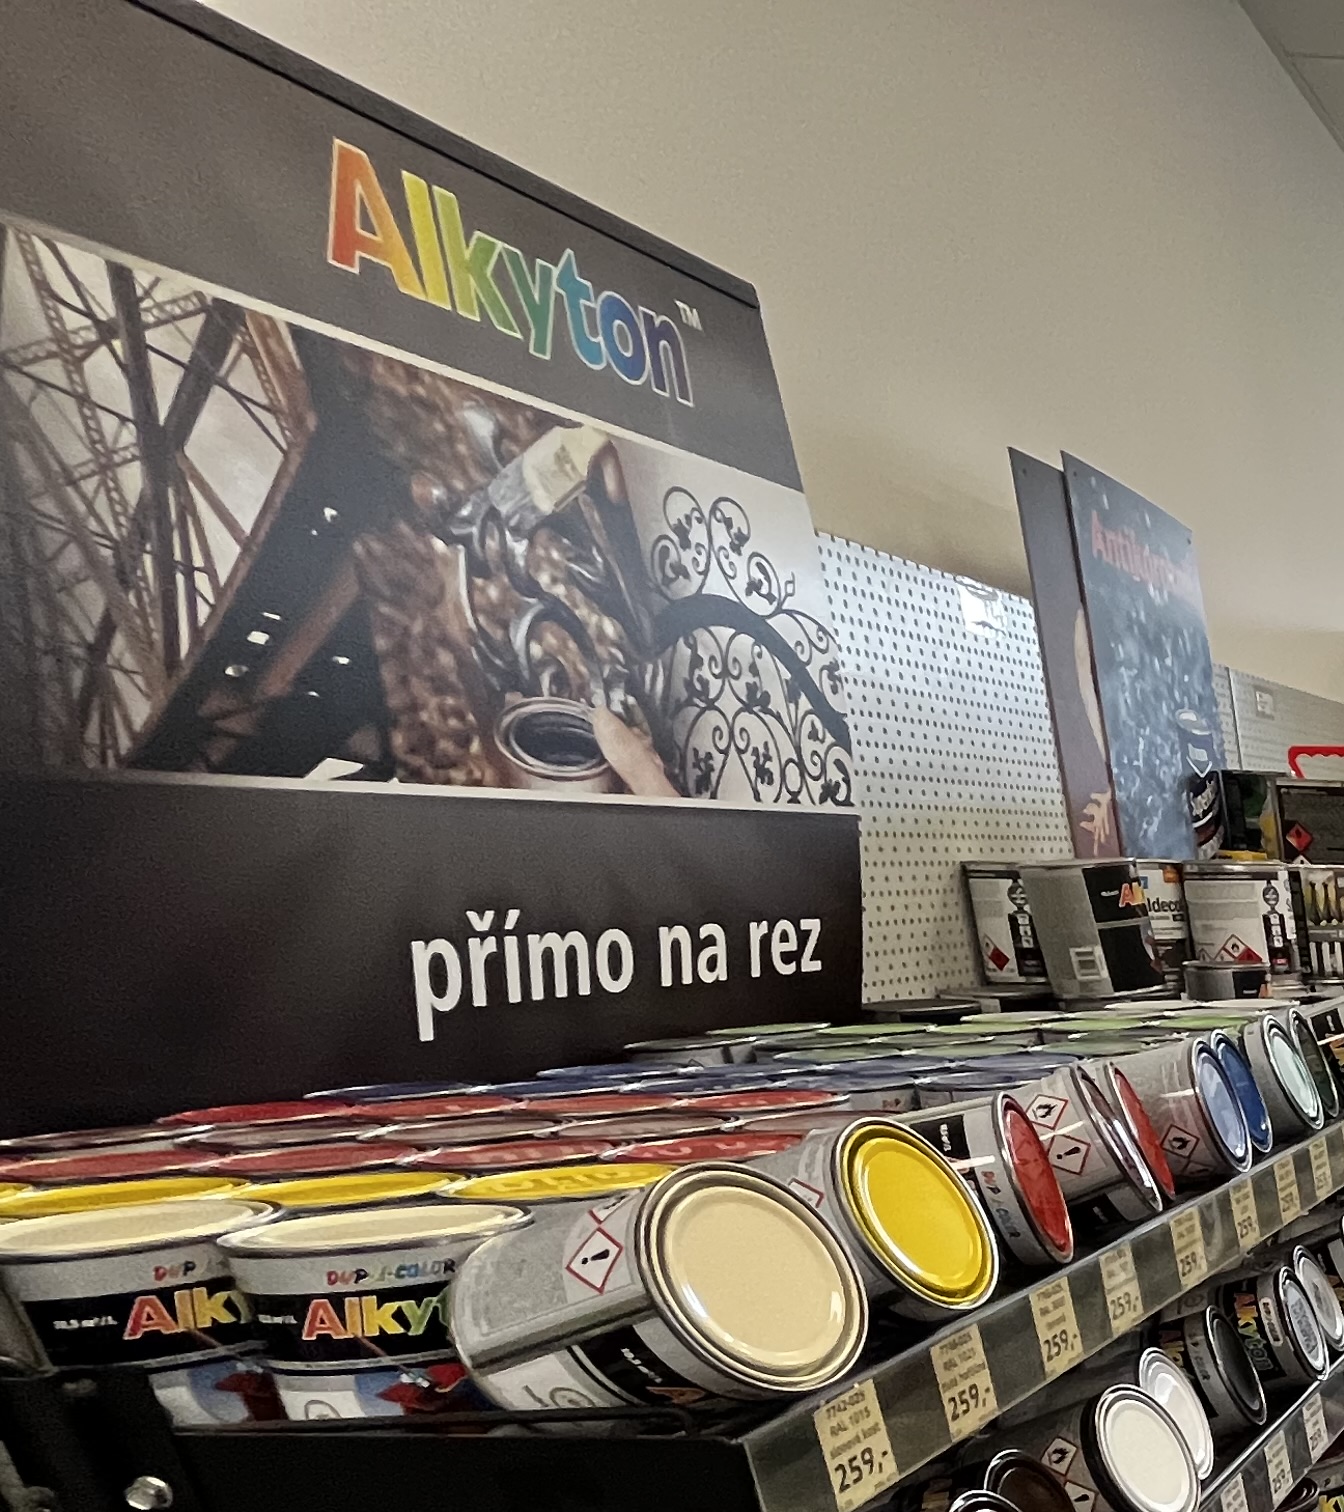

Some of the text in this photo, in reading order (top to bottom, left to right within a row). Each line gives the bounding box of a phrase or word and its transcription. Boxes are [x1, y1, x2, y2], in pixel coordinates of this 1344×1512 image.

[327, 138, 693, 406] Alkyton
[410, 909, 822, 1042] přímo na rez
[1043, 1328, 1079, 1363] 259,-
[948, 1382, 992, 1422] 259,-
[832, 1446, 889, 1493] 259,-
